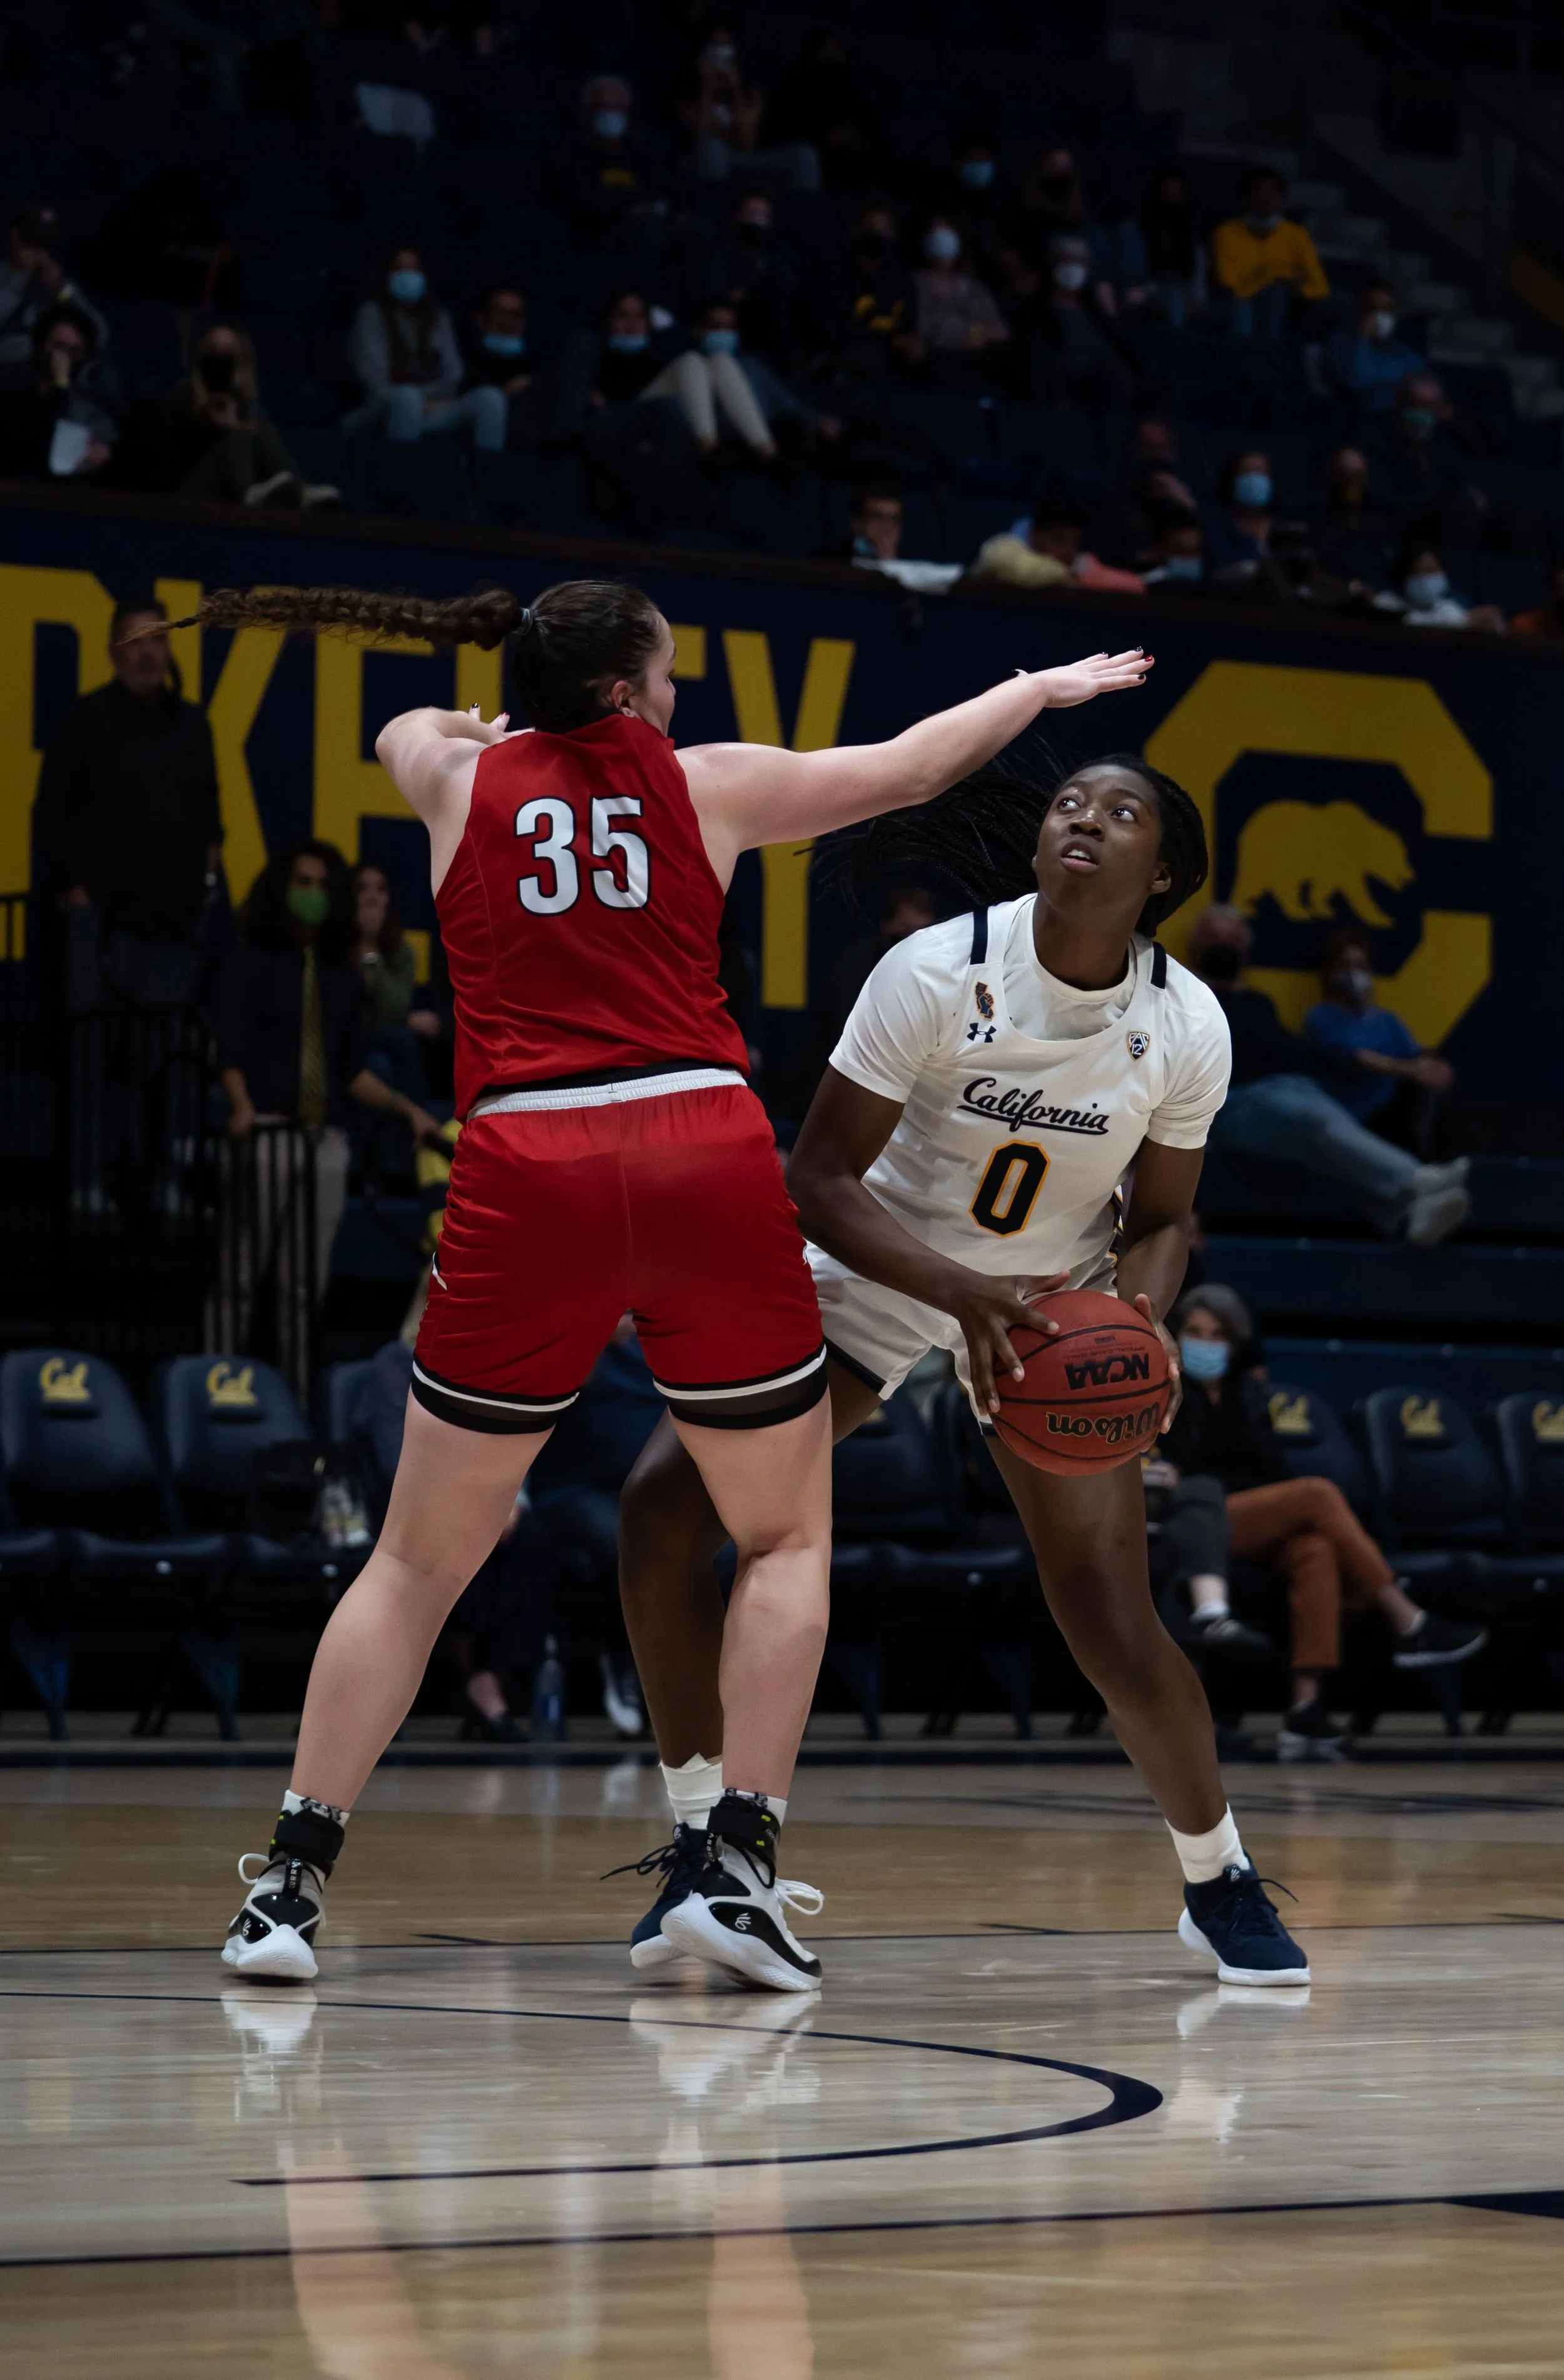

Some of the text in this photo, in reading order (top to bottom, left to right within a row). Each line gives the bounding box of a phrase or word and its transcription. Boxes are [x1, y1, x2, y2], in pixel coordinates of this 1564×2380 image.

[515, 795, 651, 917] 35
[1129, 1032, 1149, 1049] PAC
[1132, 1044, 1143, 1055] 12
[958, 1077, 1109, 1135] California
[970, 1139, 1050, 1236] 0
[1065, 1352, 1150, 1390] NCAA
[1046, 1401, 1159, 1444] Wilson
[706, 1832, 716, 1863] CURRY
